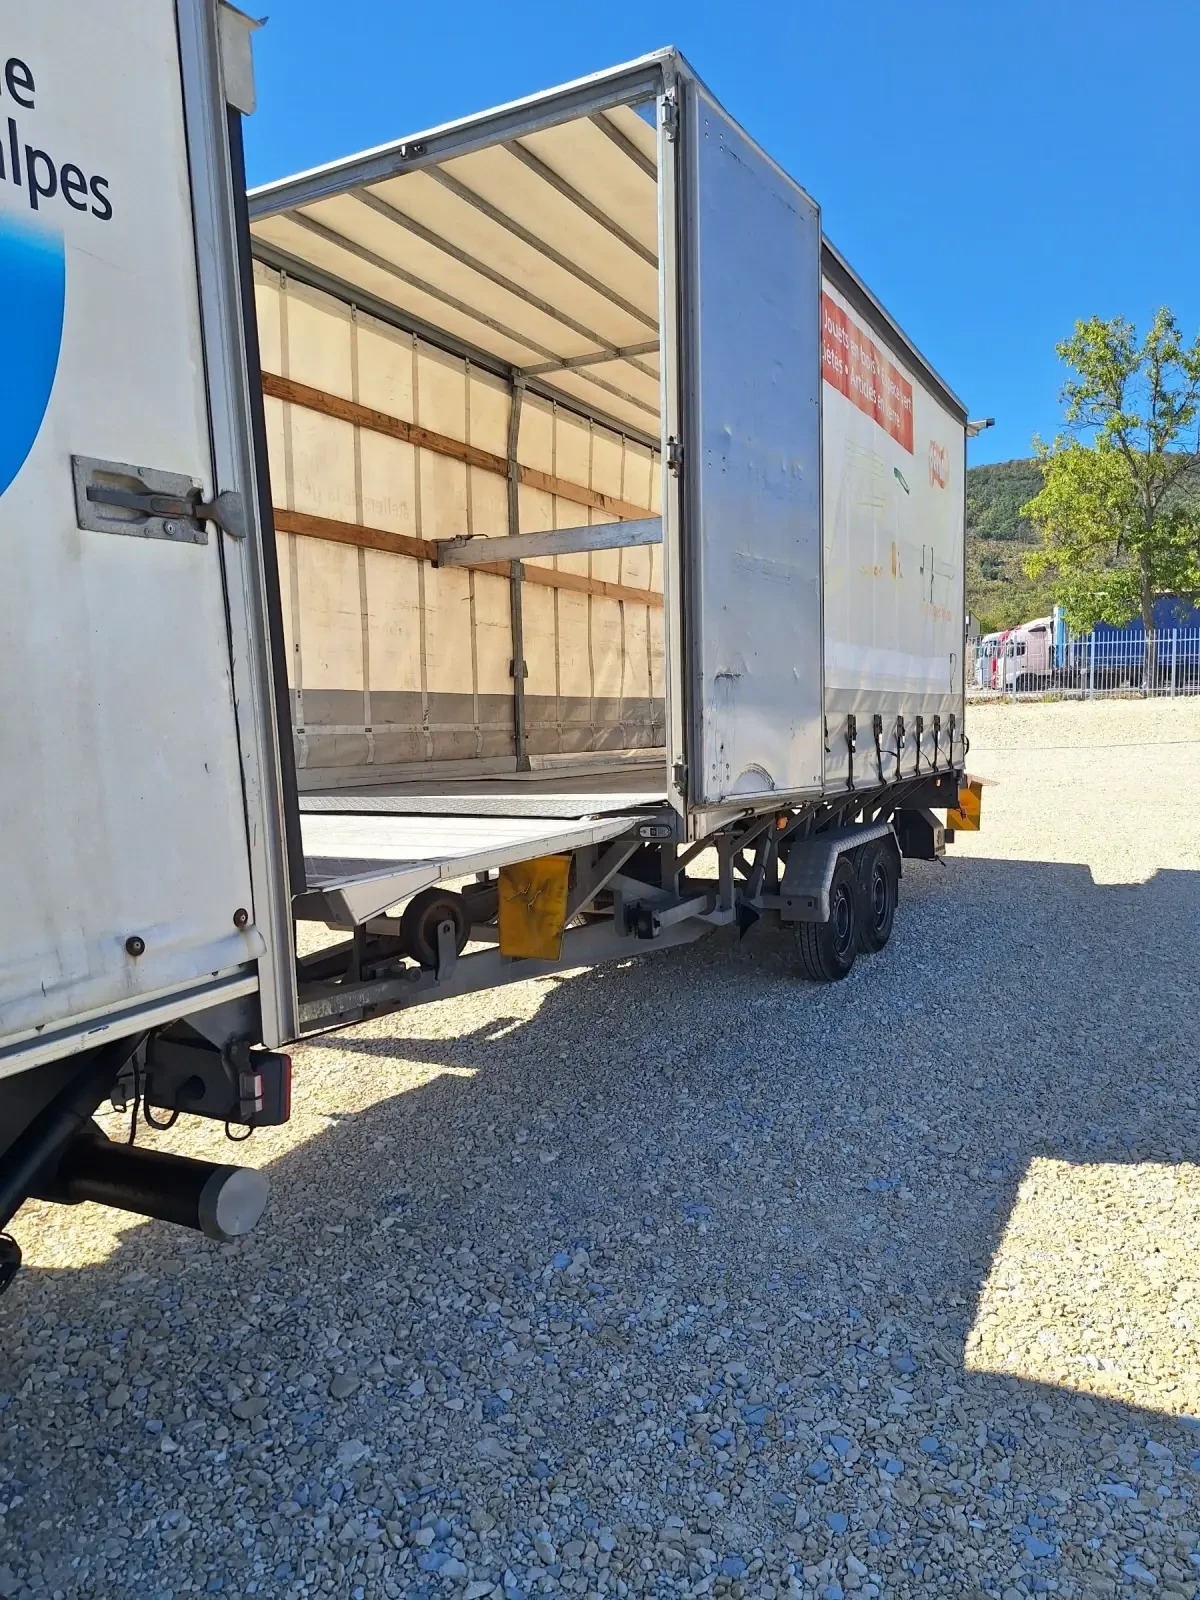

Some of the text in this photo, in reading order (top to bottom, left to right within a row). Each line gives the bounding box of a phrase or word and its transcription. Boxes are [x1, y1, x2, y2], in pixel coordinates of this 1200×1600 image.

[0, 57, 36, 110] e
[0, 116, 113, 221] lpes
[823, 308, 849, 349] Jouets
[850, 366, 877, 404] Articles
